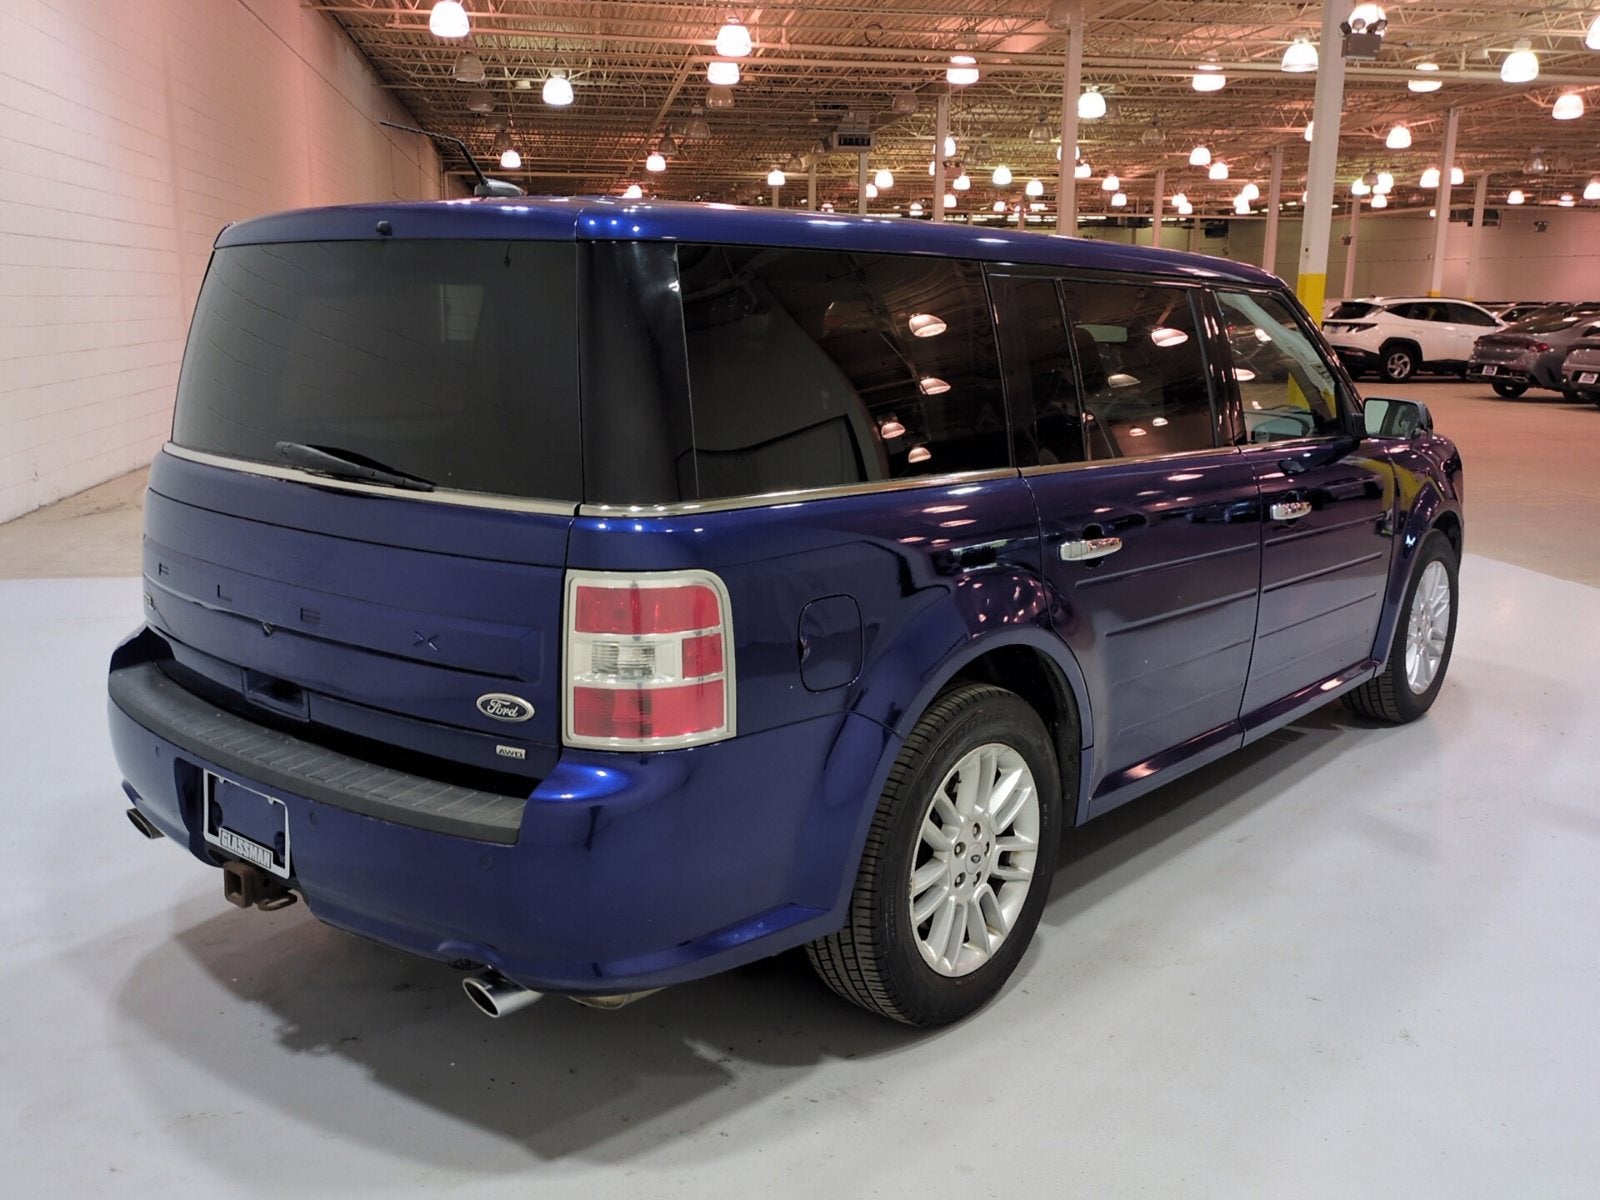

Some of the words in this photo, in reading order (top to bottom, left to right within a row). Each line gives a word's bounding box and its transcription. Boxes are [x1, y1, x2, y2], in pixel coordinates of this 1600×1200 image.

[158, 561, 442, 651] FLEX
[486, 699, 519, 717] Ford
[498, 747, 524, 758] AWD
[220, 830, 271, 868] GLASSMAN
